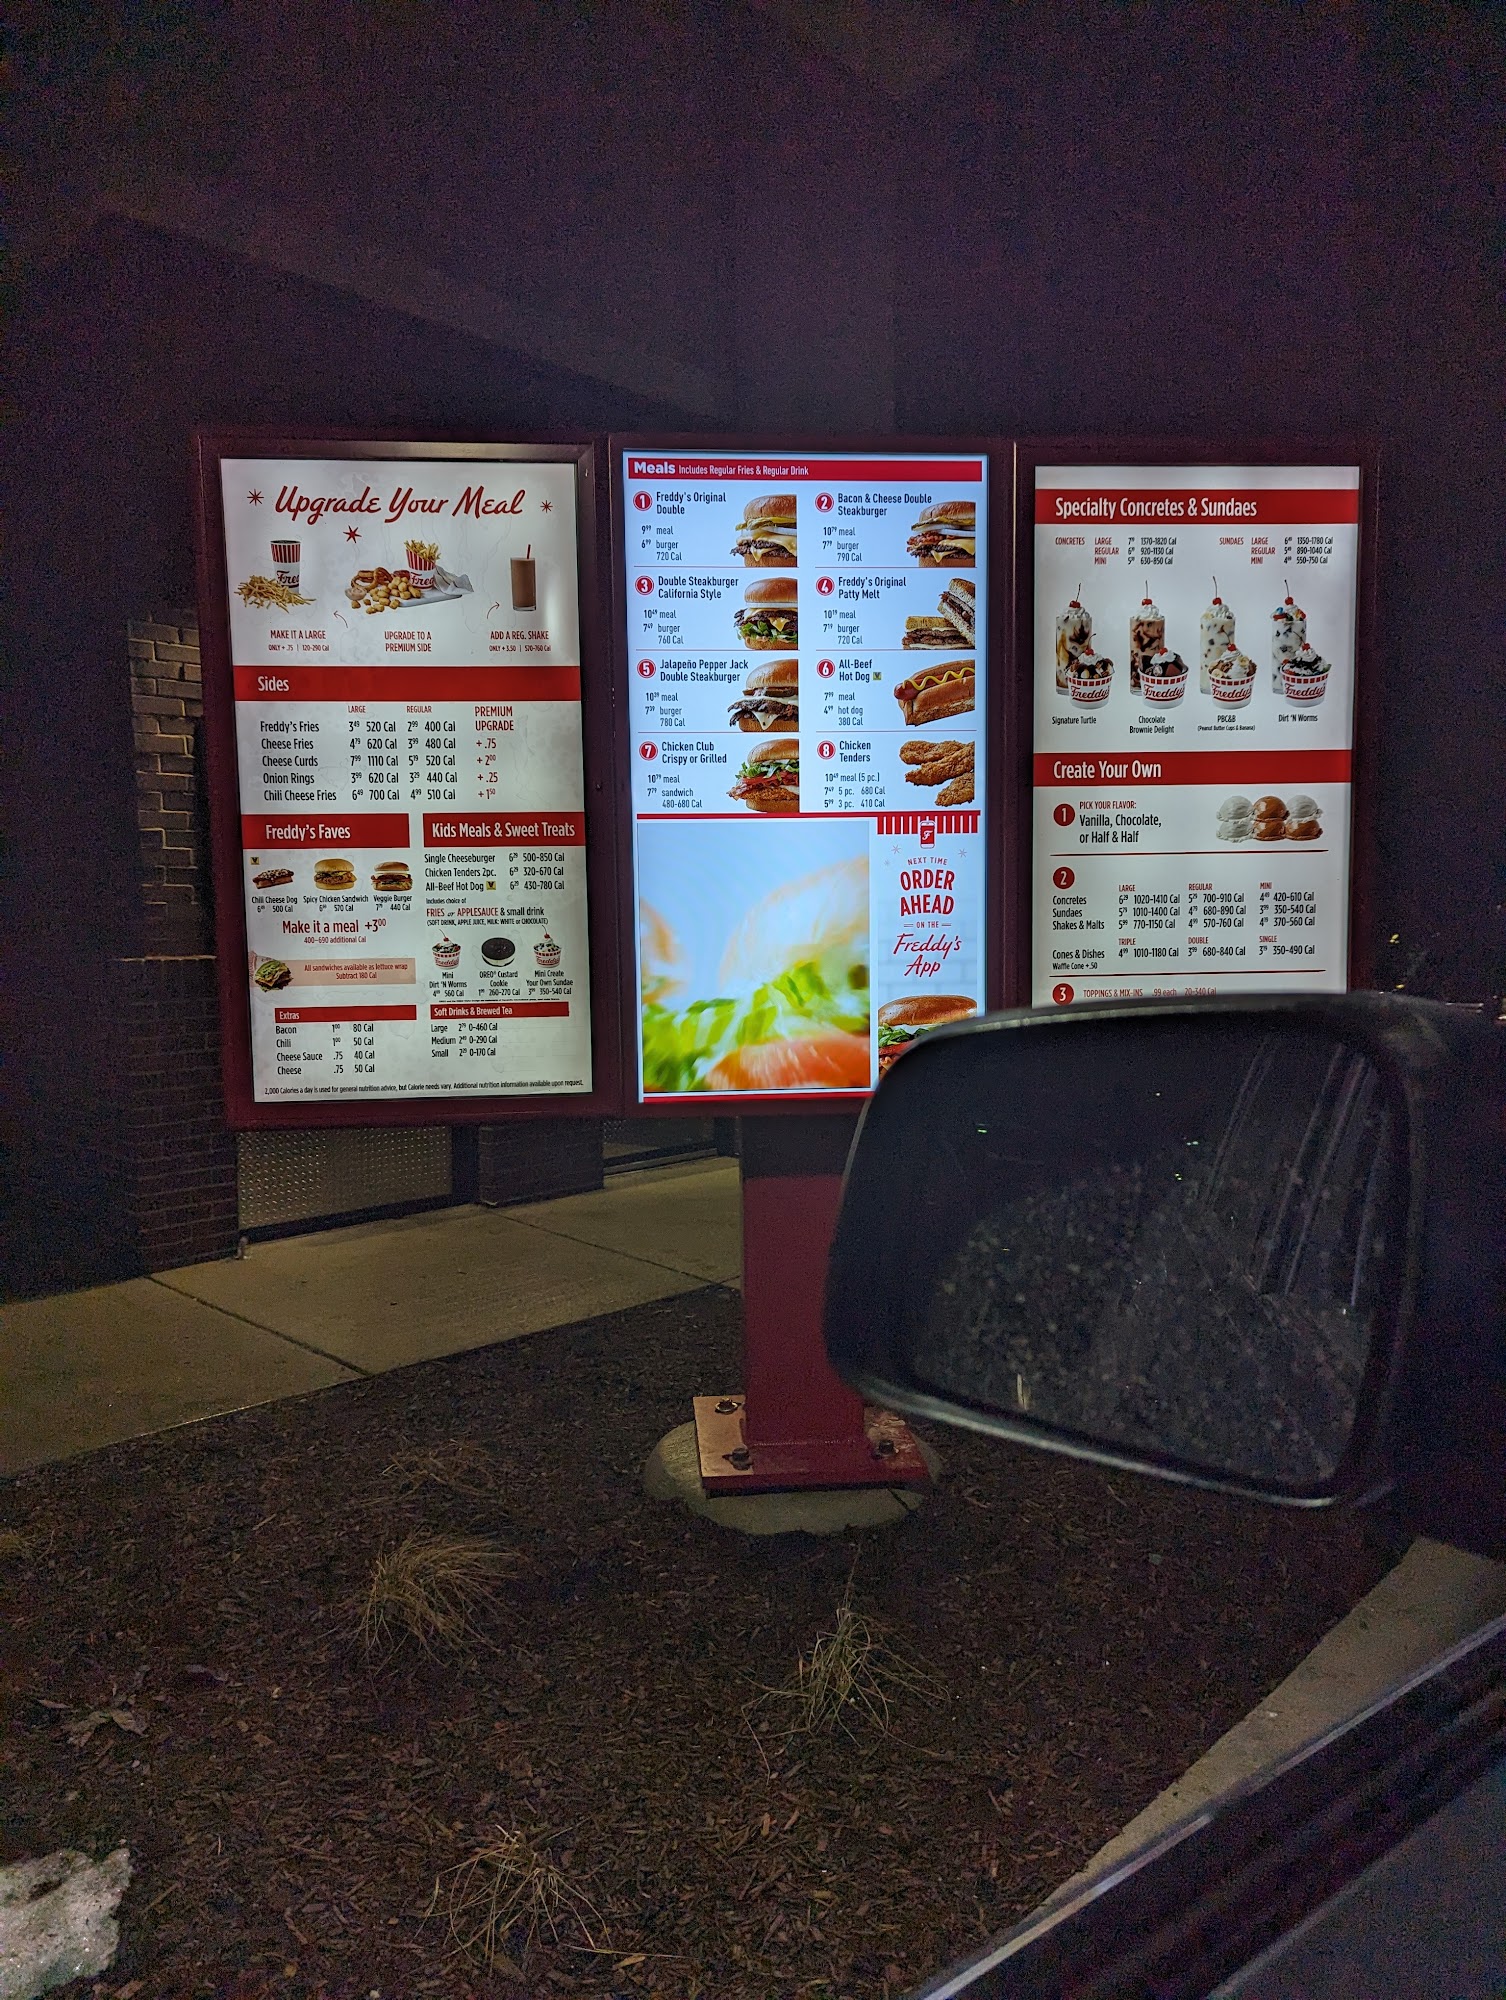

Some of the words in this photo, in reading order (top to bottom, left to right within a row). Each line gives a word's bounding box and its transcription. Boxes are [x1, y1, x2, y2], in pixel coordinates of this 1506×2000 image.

[634, 462, 675, 474] Meals
[679, 466, 707, 475] Includes
[710, 466, 736, 476] Regular
[738, 466, 754, 475] Fries
[756, 466, 761, 475] &
[763, 466, 789, 476] Regular
[791, 466, 808, 475] Drink
[640, 495, 645, 508] 1
[657, 492, 691, 503] Freddy's
[694, 493, 726, 504] Original
[821, 496, 827, 509] 2
[838, 493, 862, 503] Bacon
[865, 494, 870, 503] &
[873, 494, 902, 504] Cheese
[904, 494, 932, 504] Double
[275, 485, 381, 525] Upgrade
[384, 487, 448, 523] Your
[452, 486, 526, 519] Meal
[657, 505, 685, 514] Double
[1055, 497, 1115, 519] Specialty
[1120, 497, 1184, 516] Concretes
[1188, 497, 1197, 516] &
[1201, 497, 1257, 516] Sundaes
[838, 506, 887, 517] Steakburger
[657, 526, 673, 535] meal
[656, 540, 678, 550] burger
[1055, 537, 1085, 545] CONCRETES
[1095, 537, 1112, 545] LARGE
[1219, 537, 1244, 545] SUNDAES
[641, 579, 648, 592] 3
[658, 576, 686, 586] Double
[688, 577, 738, 588] Steakburger
[821, 580, 828, 593] 4
[838, 577, 872, 588] Freddy's
[875, 577, 906, 588] Original
[658, 589, 698, 599] California
[701, 589, 721, 600] Style
[838, 589, 859, 600] Patty
[862, 590, 880, 599] Melt
[270, 630, 289, 639] MAKE
[291, 630, 296, 639] IT
[298, 630, 303, 639] A
[304, 630, 326, 640] LARGE
[384, 631, 414, 641] UPGRADE
[416, 631, 424, 640] TO
[426, 631, 431, 640] A
[385, 643, 412, 652] PREMIUM
[415, 643, 432, 652] SIDE
[643, 663, 650, 675] 5
[660, 660, 696, 671] Jalapeño
[699, 660, 727, 670] Pepper
[730, 660, 748, 669] Jack
[822, 663, 829, 675] 6
[839, 660, 872, 669] All-Beef
[660, 672, 688, 682] Double
[690, 672, 740, 683] Steakburger
[839, 672, 853, 681] Hot
[856, 672, 870, 683] Dog
[258, 677, 289, 692] Sides
[348, 706, 366, 714] LARGE
[407, 706, 432, 714] REGULAR
[475, 706, 512, 717] PREMIUM
[1052, 716, 1079, 726] Signature
[1080, 716, 1096, 724] Turtle
[1138, 715, 1165, 724] Chocolate
[1217, 715, 1236, 723] PBC&B
[1278, 714, 1289, 722] Dirt
[1298, 714, 1318, 722] Worms
[260, 720, 297, 734] Freddy's
[299, 721, 319, 732] Fries
[475, 721, 514, 731] UPGRADE
[1129, 725, 1152, 733] Brownie
[1154, 725, 1174, 735] Delight
[261, 738, 289, 750] Cheese
[292, 738, 313, 750] Fries
[662, 742, 694, 751] Chicken
[696, 742, 714, 751] Club
[839, 741, 871, 750] Chicken
[645, 745, 651, 758] 7
[823, 744, 829, 756] 8
[262, 756, 291, 767] Cheese
[293, 756, 318, 767] Curds
[662, 754, 687, 766] Crispy
[700, 754, 727, 763] Grilled
[840, 753, 870, 762] Tenders
[1054, 761, 1095, 779] Create
[1098, 760, 1128, 779] Your
[1132, 760, 1162, 778] Own
[263, 773, 288, 784] Onion
[291, 772, 315, 787] Rings
[264, 790, 282, 802] Chili
[284, 789, 314, 801] Cheese
[317, 789, 337, 801] Fries
[1080, 801, 1093, 809] PICK
[1095, 801, 1111, 809] YOUR
[1113, 801, 1136, 809] FLAVOR:
[1061, 809, 1066, 822] 1
[1080, 815, 1112, 828] Vanilla,
[1116, 814, 1161, 827] Chocolate,
[266, 825, 316, 841] Freddy's
[319, 824, 350, 839] Faves
[432, 823, 456, 838] Kids
[459, 823, 491, 837] Meals
[494, 823, 502, 837] &
[505, 823, 539, 837] Sweet
[542, 822, 575, 837] Treats
[1080, 833, 1089, 843] or
[1092, 832, 1109, 843] Half
[1112, 832, 1118, 843] &
[1121, 831, 1139, 843] Half
[424, 854, 446, 864] Single
[448, 854, 495, 864] Cheeseburger
[908, 857, 927, 865] NEXT
[930, 857, 947, 865] TIME
[425, 868, 451, 877] Chicken
[454, 868, 480, 877] Tenders
[482, 868, 496, 878] 2pc.
[1060, 871, 1066, 885] 2
[900, 869, 955, 891] ORDER
[426, 882, 454, 891] All-Beef
[456, 882, 468, 891] Hot
[470, 882, 484, 892] Dog
[900, 894, 954, 916] AHEAD
[1053, 896, 1086, 905] Concretes
[427, 908, 445, 917] FRIES
[457, 908, 498, 916] APPLESAUCE
[500, 908, 505, 916] &
[507, 908, 525, 916] small
[527, 907, 544, 916] drink
[1053, 909, 1082, 917] Sundaes
[283, 921, 310, 934] Make
[313, 921, 320, 933] it
[323, 923, 329, 932] a
[333, 920, 359, 932] meal
[1053, 921, 1077, 930] Shakes
[1079, 921, 1084, 929] &
[1086, 920, 1104, 929] Malts
[893, 933, 962, 959] Freddy's
[1053, 950, 1073, 959] Cones
[1075, 950, 1080, 958] &
[1081, 949, 1105, 959] Dishes
[904, 954, 941, 977] App
[1060, 987, 1066, 1001] 3
[434, 1008, 447, 1016] Soft
[449, 1008, 468, 1016] Drinks
[477, 1007, 500, 1015] Brewed
[502, 1006, 512, 1015] Tea
[276, 1026, 297, 1034] Bacon
[431, 1024, 448, 1033] Large
[277, 1039, 291, 1047] Chili
[432, 1036, 456, 1045] Medium
[277, 1053, 301, 1061] Cheese
[303, 1052, 322, 1061] Sauce
[432, 1049, 448, 1058] Small
[278, 1066, 301, 1075] Cheese
